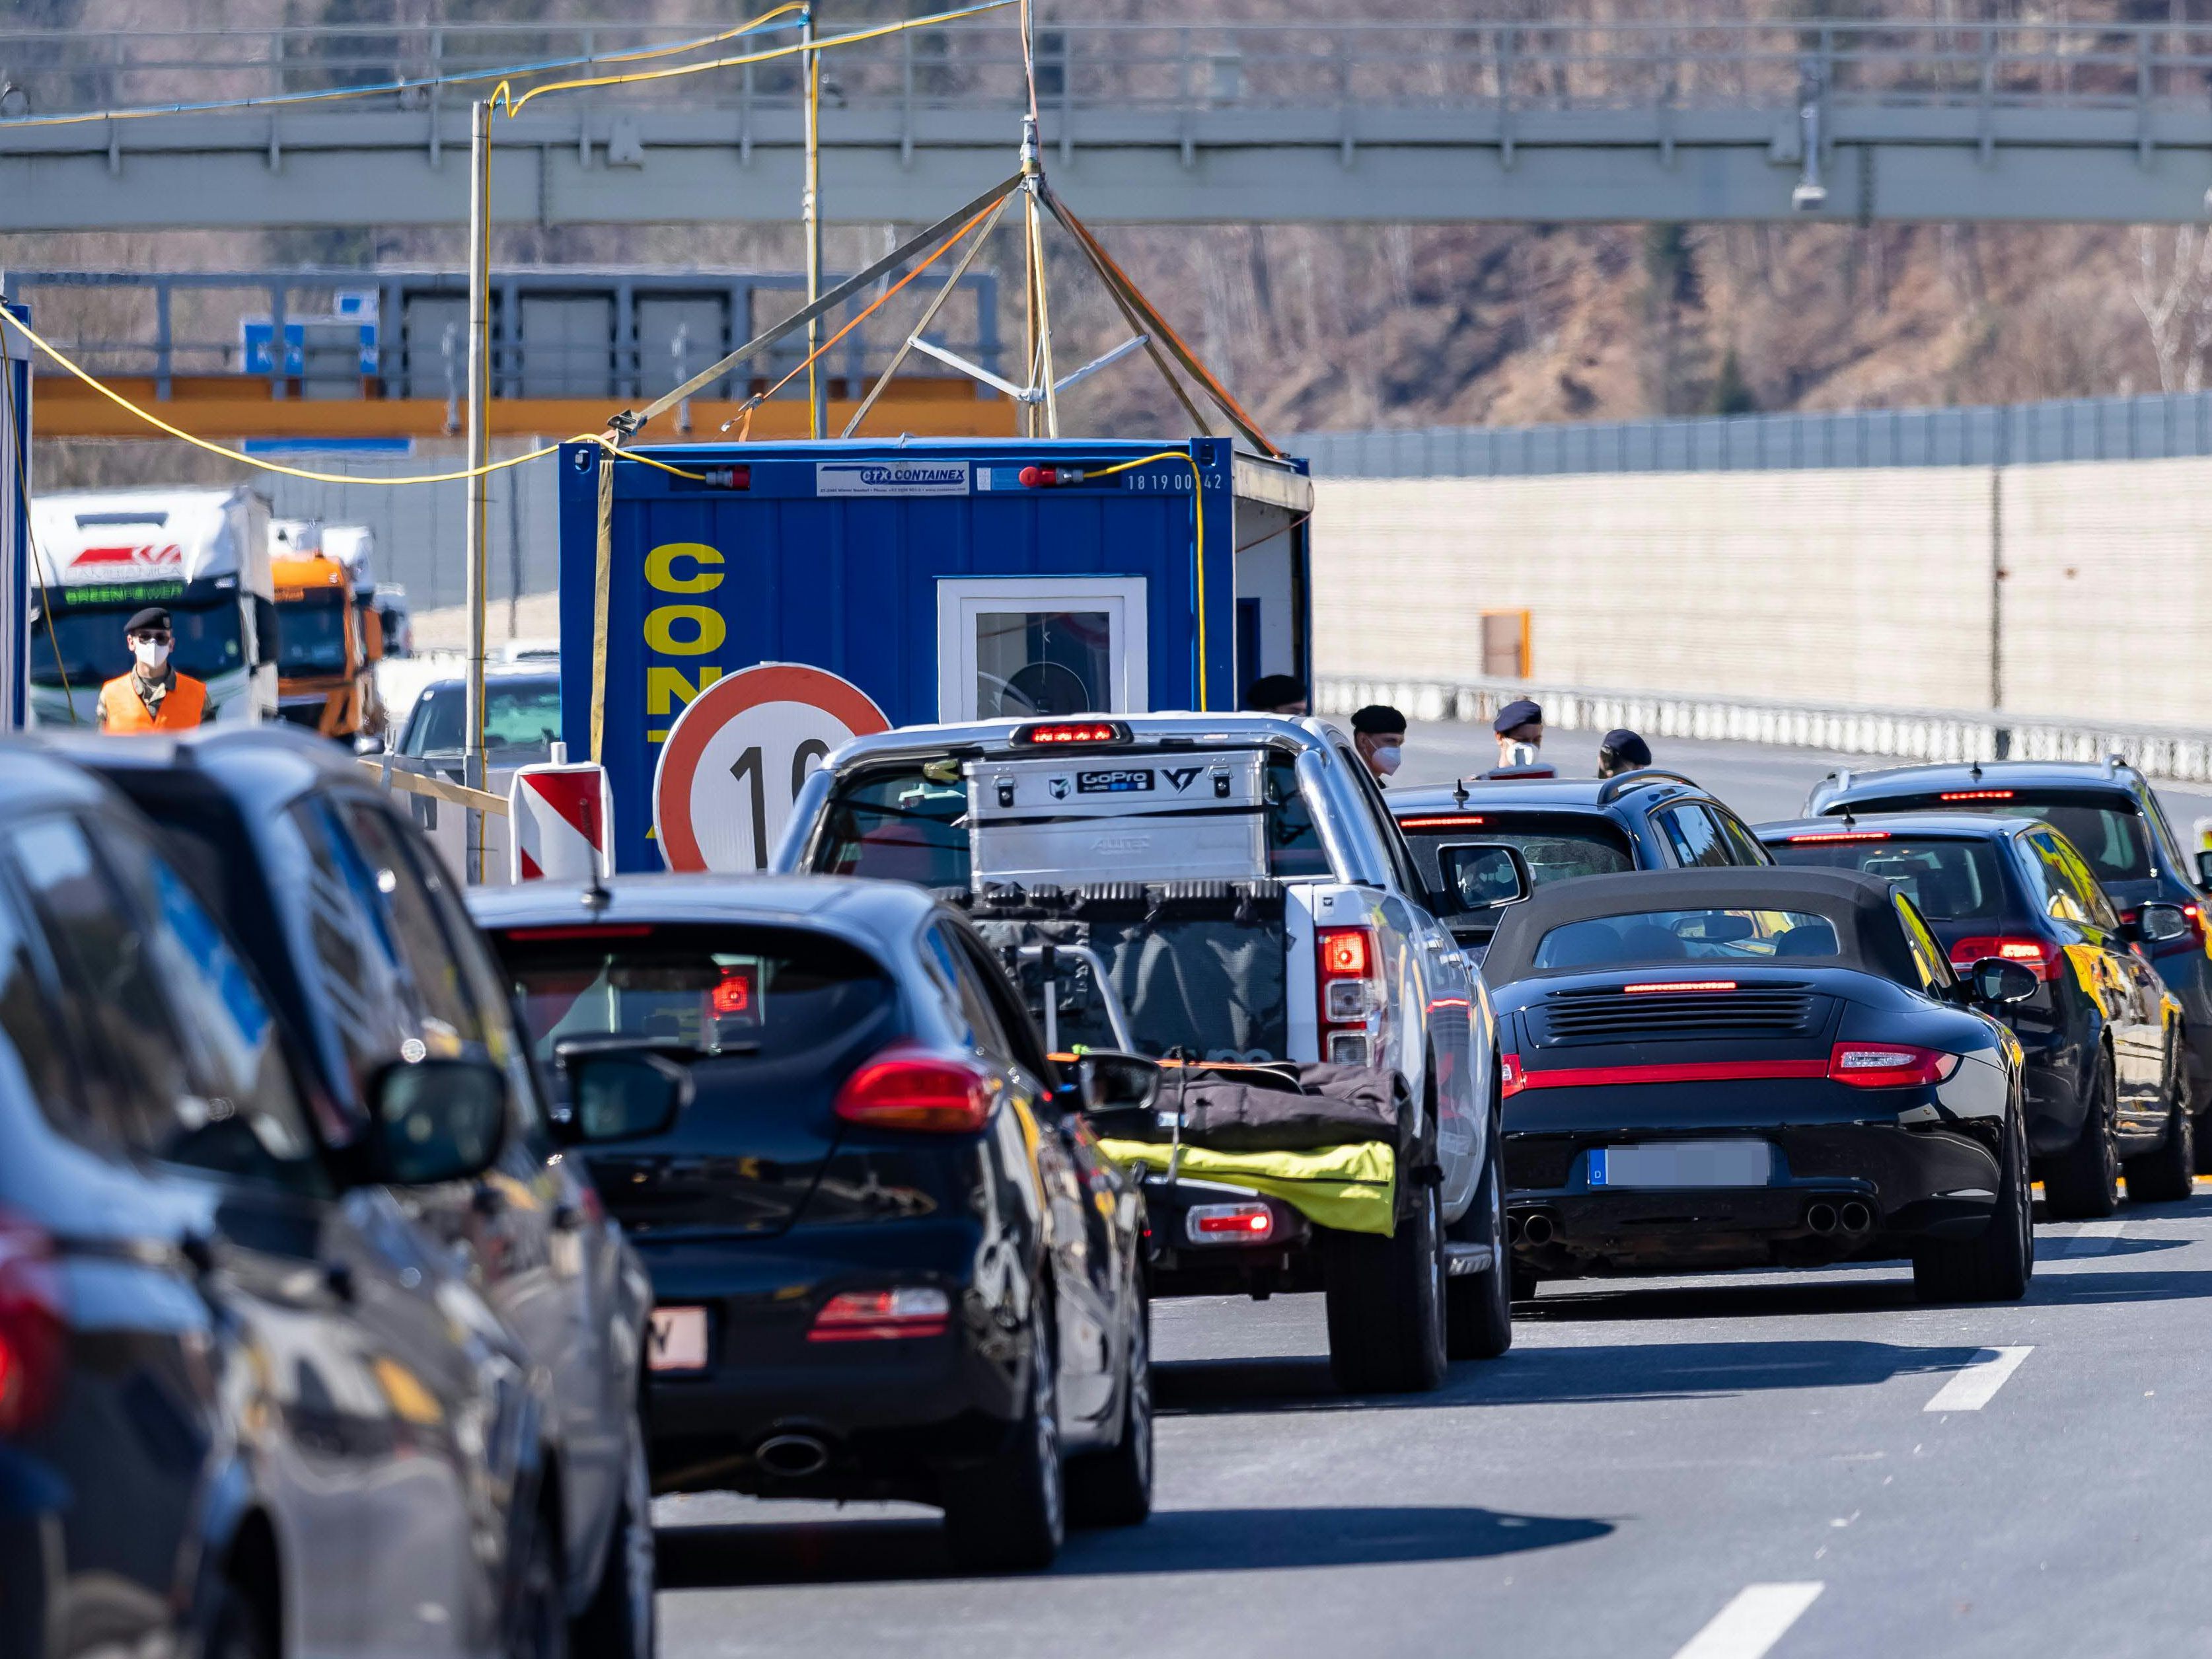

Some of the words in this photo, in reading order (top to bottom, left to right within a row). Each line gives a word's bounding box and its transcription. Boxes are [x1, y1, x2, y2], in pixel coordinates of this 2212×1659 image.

[862, 470, 889, 480] CTX
[895, 469, 965, 480] CONTAINEX
[1128, 475, 1145, 490] 18
[1152, 474, 1168, 490] 19
[644, 542, 726, 838] CON
[1082, 772, 1147, 784] GoPro
